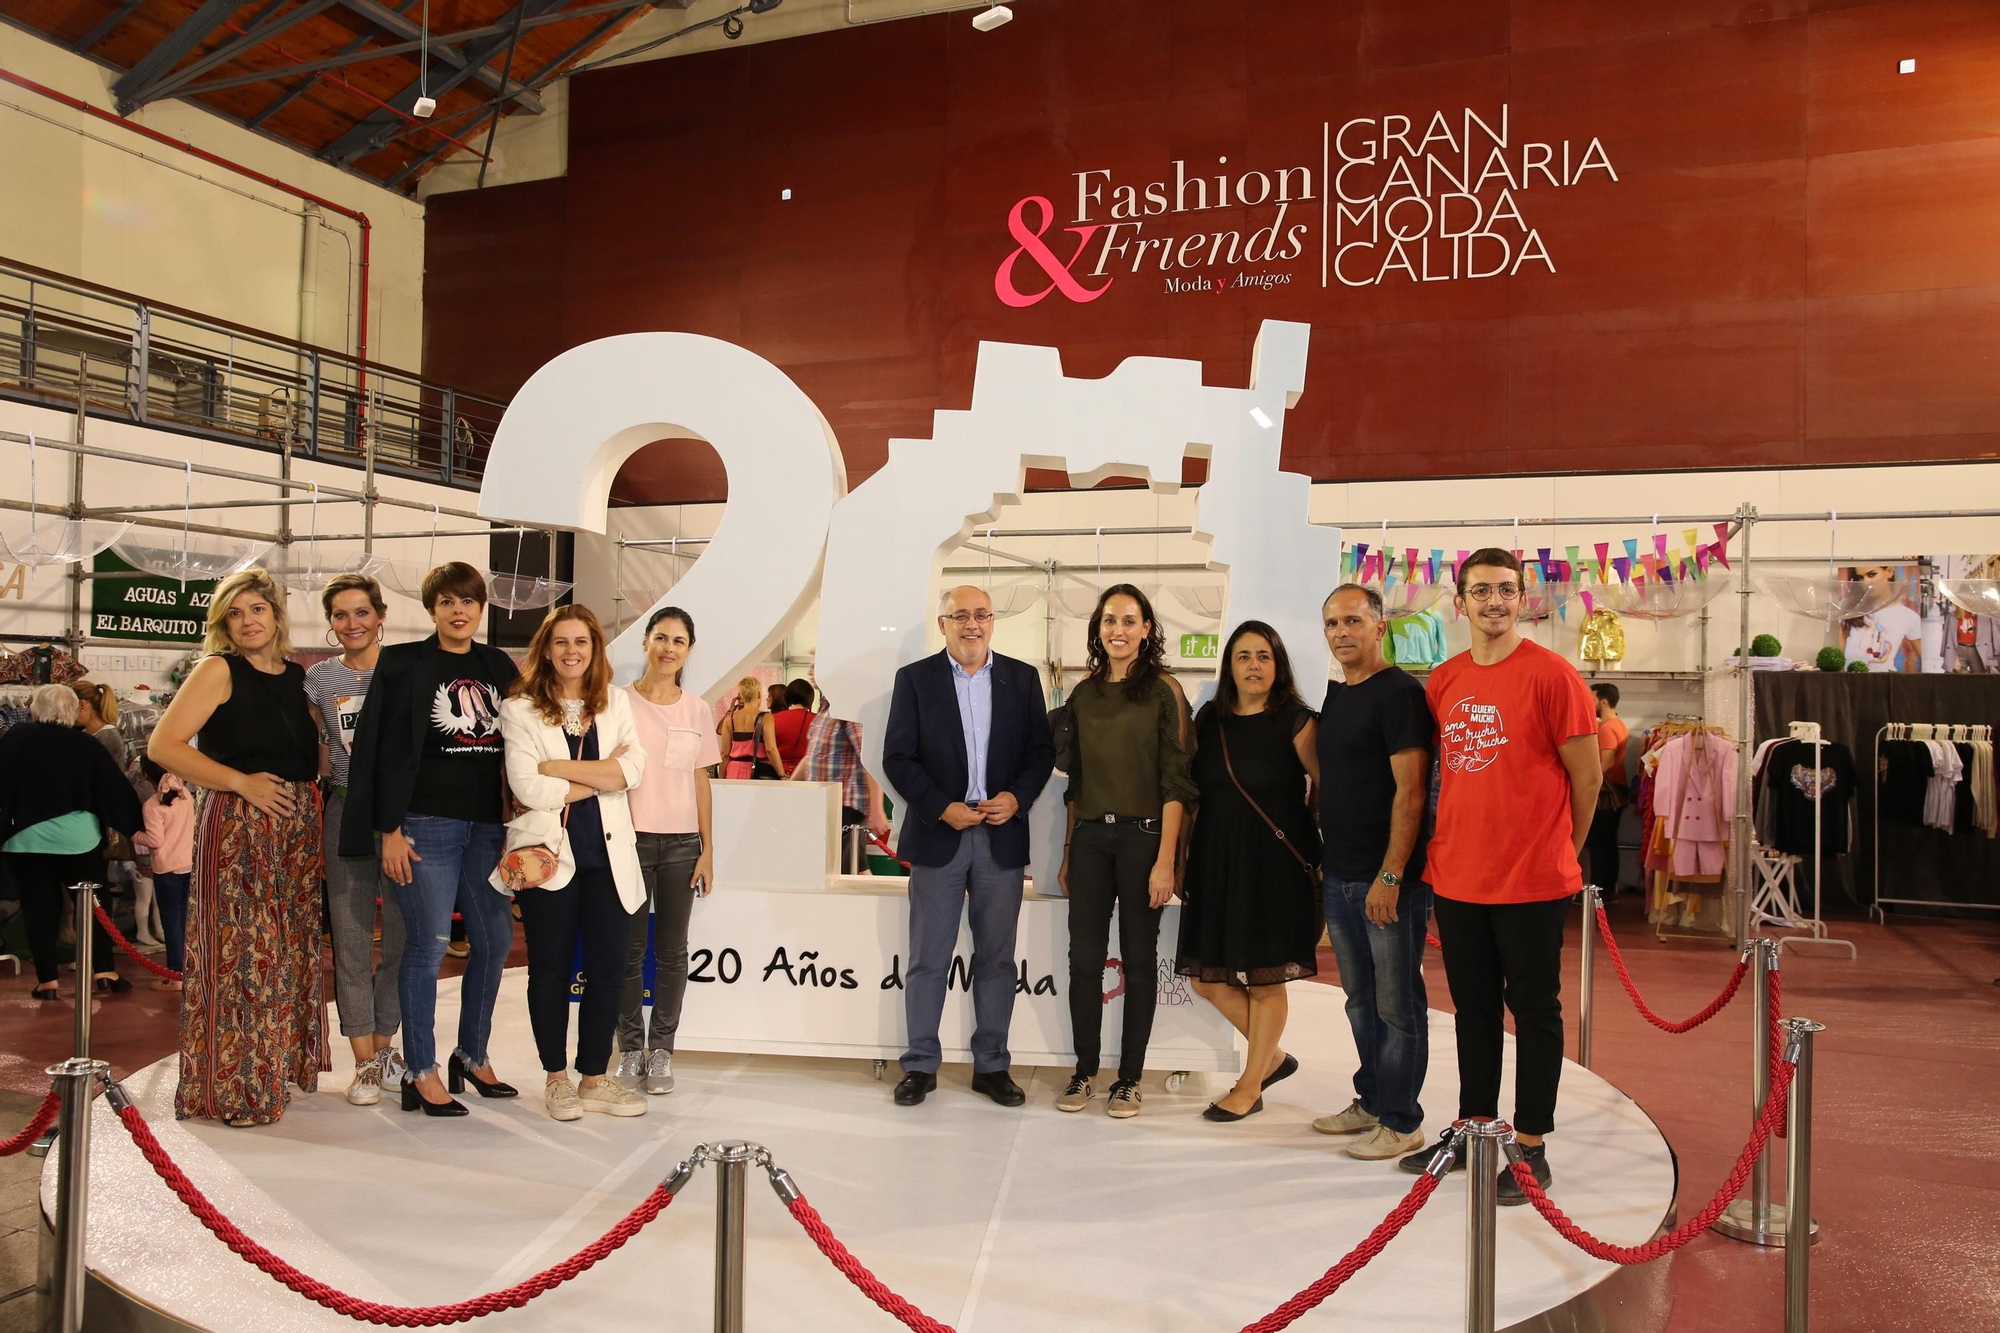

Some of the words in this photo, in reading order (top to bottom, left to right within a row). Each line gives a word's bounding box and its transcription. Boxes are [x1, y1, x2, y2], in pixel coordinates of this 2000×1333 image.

[1336, 103, 1508, 193] GRAN
[1335, 136, 1619, 204] CANARIA
[1070, 156, 1317, 223] Fashion
[1336, 187, 1528, 246] MODA
[1086, 202, 1308, 277] Friends
[1163, 276, 1212, 294] Moda
[1216, 277, 1227, 294] y
[1230, 269, 1293, 291] Amigos
[123, 586, 177, 606] AGUAS
[95, 613, 118, 632] EL
[119, 615, 197, 636] BARQUITO
[1461, 703, 1471, 713] TE
[1471, 704, 1496, 715] QUIERO
[1470, 713, 1495, 724] MUCHO
[687, 948, 742, 984] 20
[762, 946, 859, 990] Años
[880, 954, 904, 990] d
[948, 952, 1057, 996] Mda
[1157, 993, 1194, 1006] LIDA
